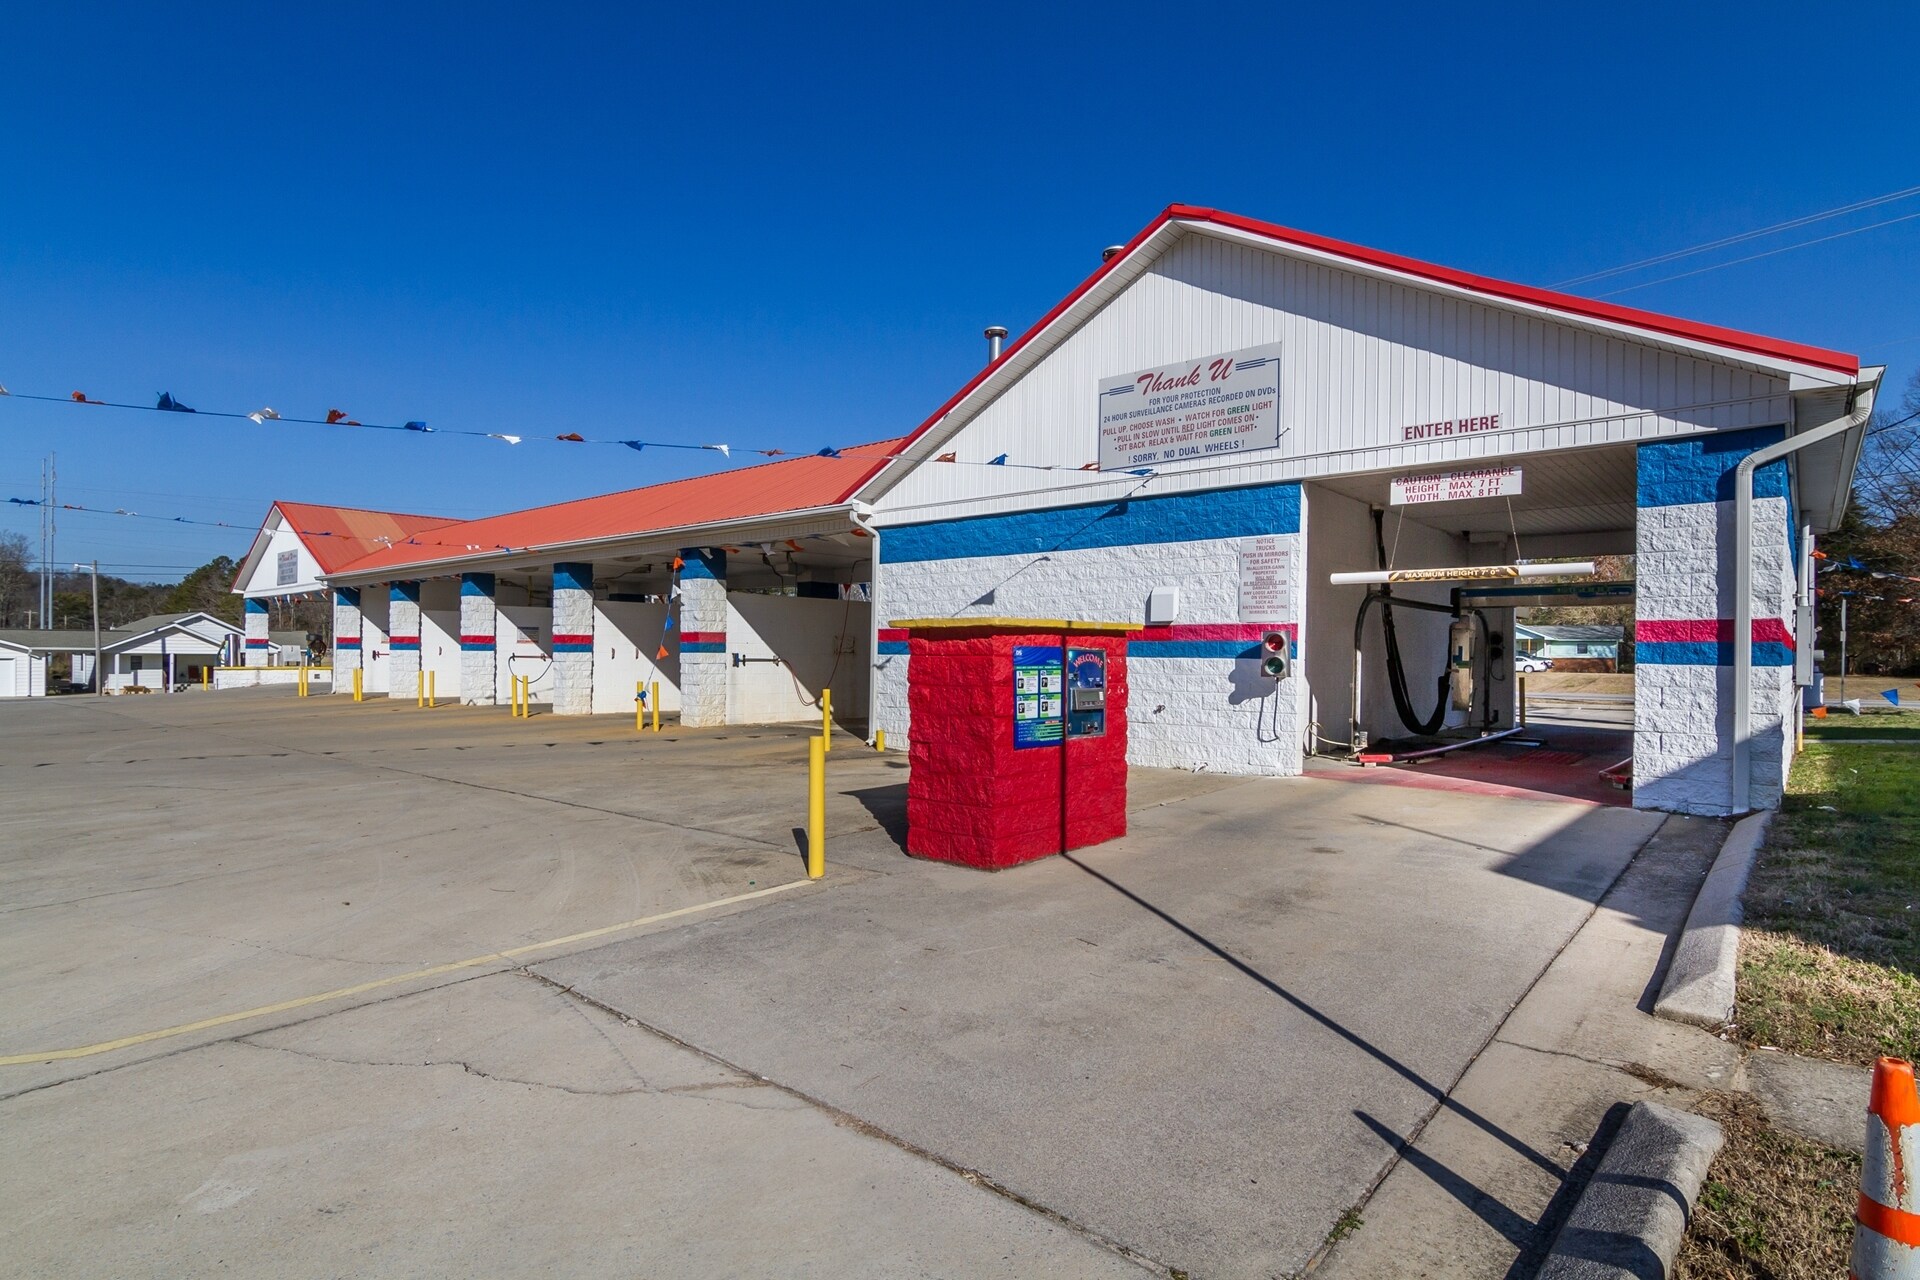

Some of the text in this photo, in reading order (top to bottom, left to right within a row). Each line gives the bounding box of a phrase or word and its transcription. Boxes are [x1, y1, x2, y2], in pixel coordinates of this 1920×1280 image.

[1137, 358, 1234, 396] Thank U
[1103, 386, 1276, 423] 24 HOUR SURVEILLANCE CAMERAS RECORDED ON DVDs
[1149, 387, 1221, 406] FOR YOUR PROTECTION
[1102, 427, 1117, 436] PULL
[1129, 420, 1154, 432] CHOOSE
[1155, 417, 1176, 427] WASH
[1185, 411, 1210, 421] WATCH
[1211, 409, 1226, 418] FOR
[1227, 405, 1250, 415] GREEN
[1251, 400, 1273, 411] LIGHT
[1404, 414, 1500, 441] ENTER HERE
[1117, 413, 1255, 443] PULL IN SLOW UNTIL RED LIGHT COMES ON
[1118, 423, 1255, 452] SIT BACK RELAX & WAIT FOR GREEN LIGHT
[1163, 449, 1176, 459] NO
[1178, 445, 1201, 457] DUAL
[1204, 440, 1240, 453] WHEELS
[1450, 466, 1515, 481] CLEARANCE
[1448, 489, 1475, 499] MAX.
[1478, 488, 1485, 497] 8
[1487, 487, 1503, 496] FT.
[1449, 480, 1476, 490] MAX.
[1480, 479, 1486, 488] 7
[1488, 478, 1504, 487] FT.
[1404, 570, 1446, 579] MAXIMUM
[1446, 568, 1479, 577] HEIGHT
[1073, 653, 1104, 668] WELCOME
